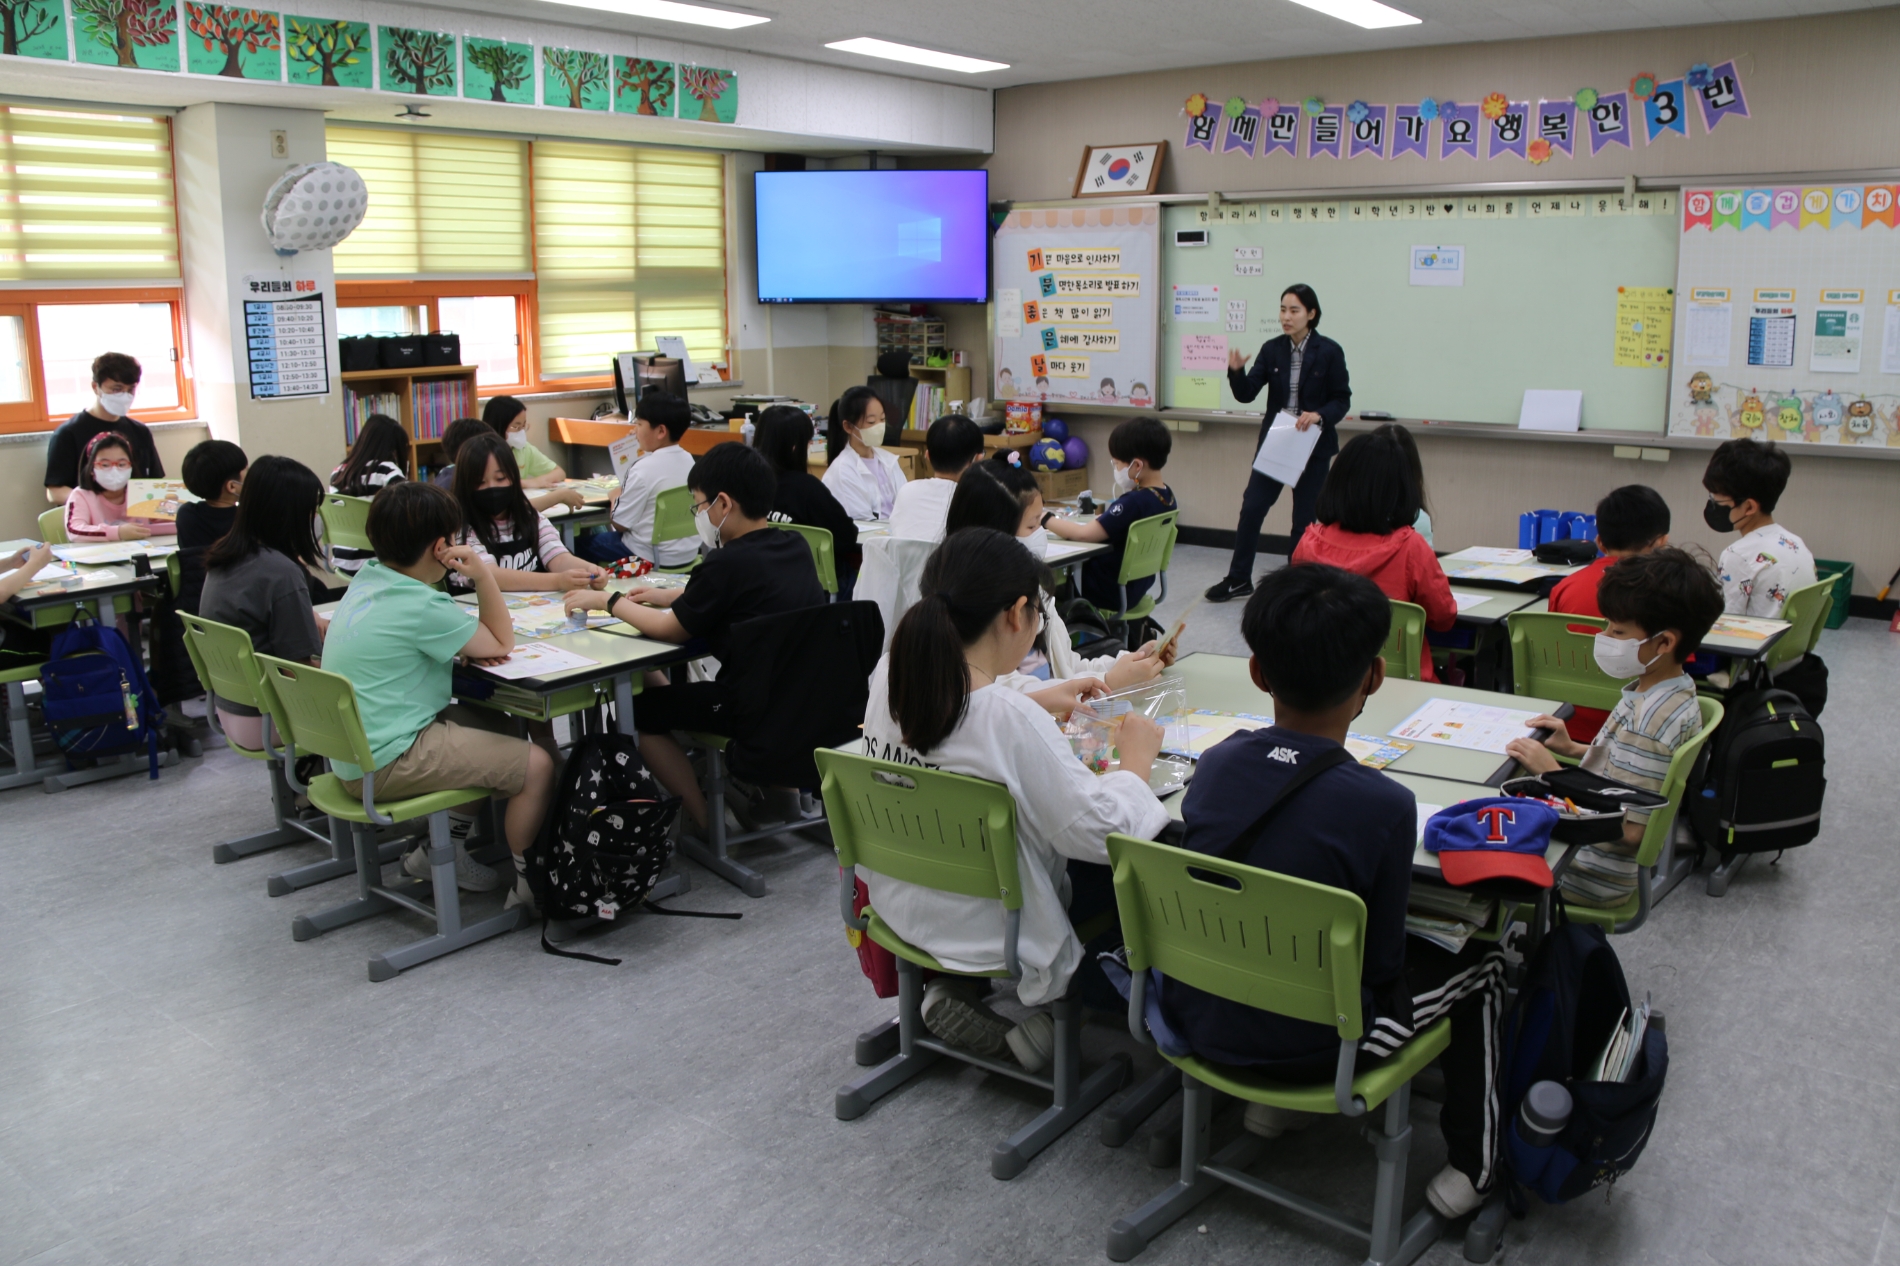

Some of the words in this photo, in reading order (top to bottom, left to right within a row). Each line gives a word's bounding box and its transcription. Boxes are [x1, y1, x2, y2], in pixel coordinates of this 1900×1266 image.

[1692, 194, 1734, 211] 함께
[1751, 194, 1823, 210] 즐겁게
[1271, 209, 1279, 218] 더
[1294, 207, 1336, 219] 행복한
[1468, 202, 1513, 215] 너희를
[1532, 201, 1580, 213] 언제나
[1056, 253, 1083, 265] 마음으로
[1086, 253, 1119, 265] 인사하기
[250, 280, 292, 293] 우리들의
[295, 280, 316, 292] 하루
[1055, 307, 1064, 319] 책
[1071, 307, 1089, 319] 많이
[1094, 307, 1111, 319] 읽기
[1083, 334, 1116, 346] 감사하기
[281, 349, 316, 357] 11:30-12:10
[281, 361, 317, 369] 12:10-12:50
[1070, 361, 1085, 373] 웃기
[283, 384, 318, 392] 13:40-14:20
[1267, 746, 1300, 764] ASK
[1477, 807, 1515, 844] T
